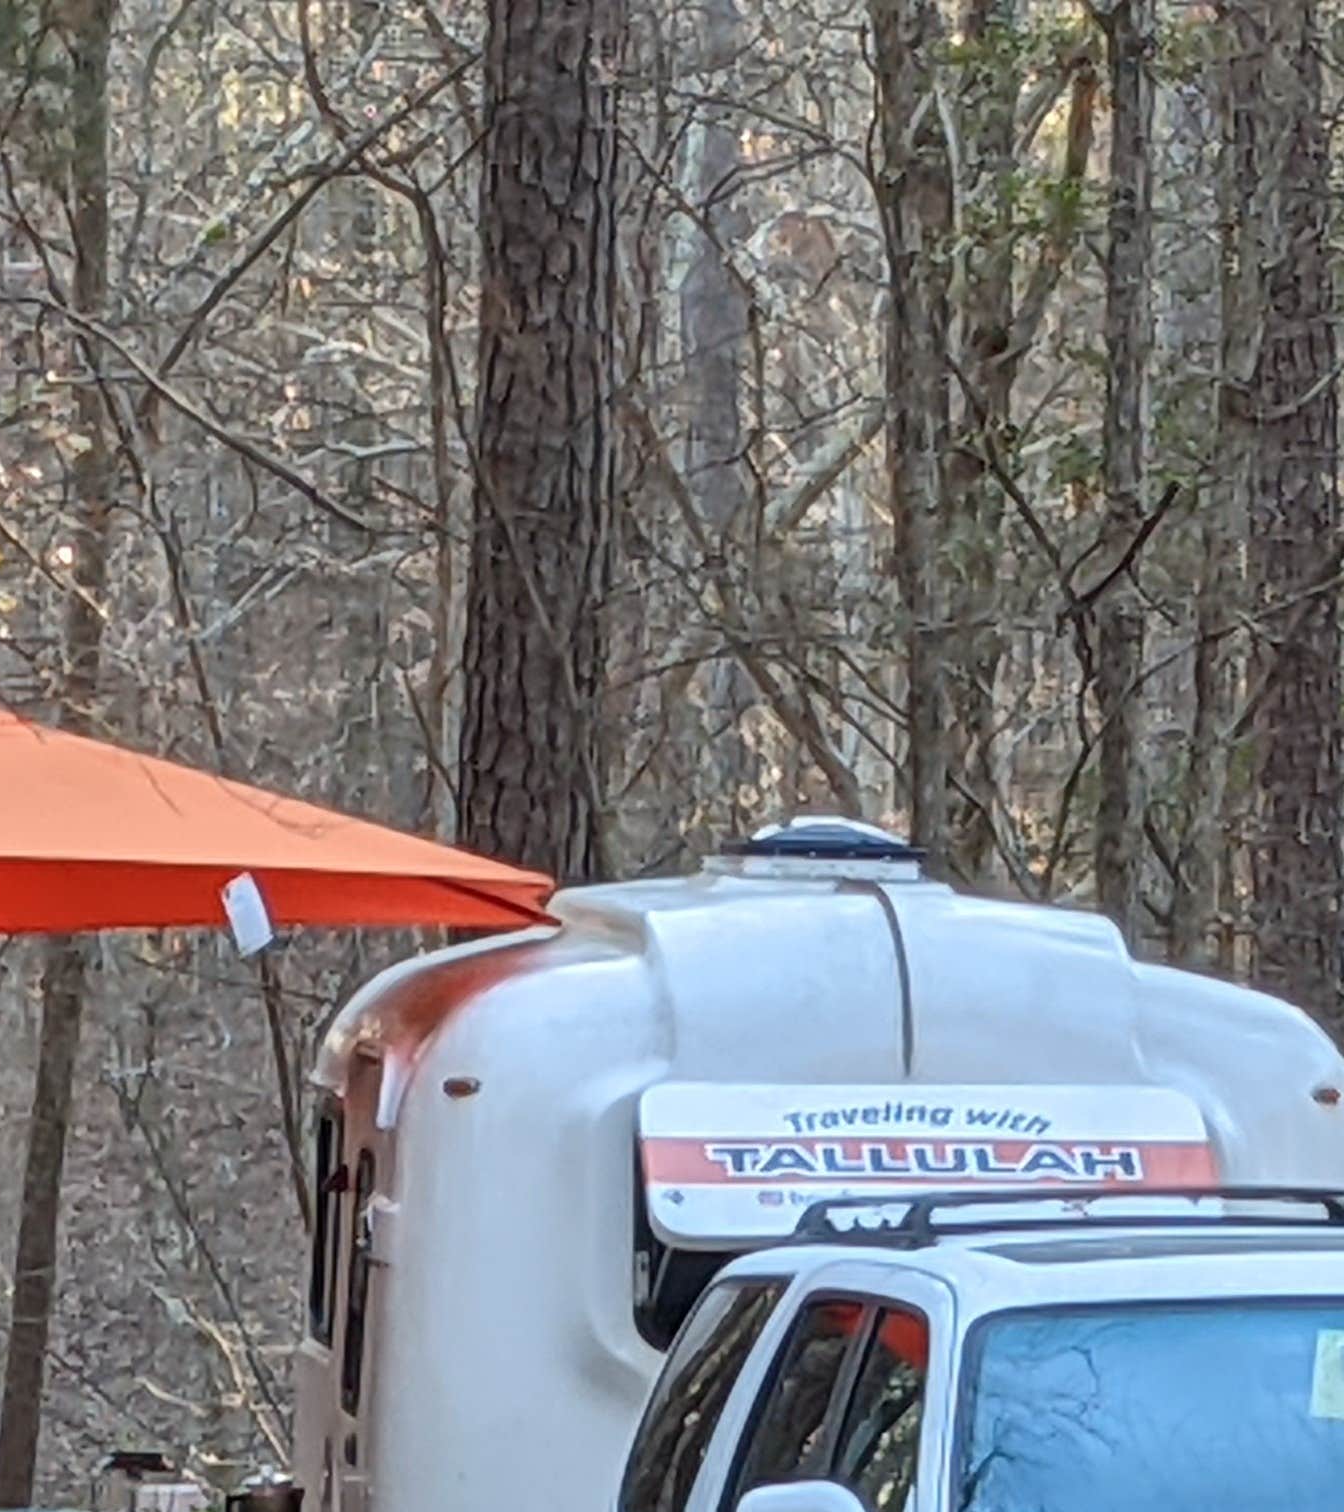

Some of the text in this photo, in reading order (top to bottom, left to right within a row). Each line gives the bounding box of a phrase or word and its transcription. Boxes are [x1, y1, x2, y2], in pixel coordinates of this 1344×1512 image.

[783, 1101, 1051, 1135] Traveling with
[706, 1143, 1141, 1180] TALLULAH
